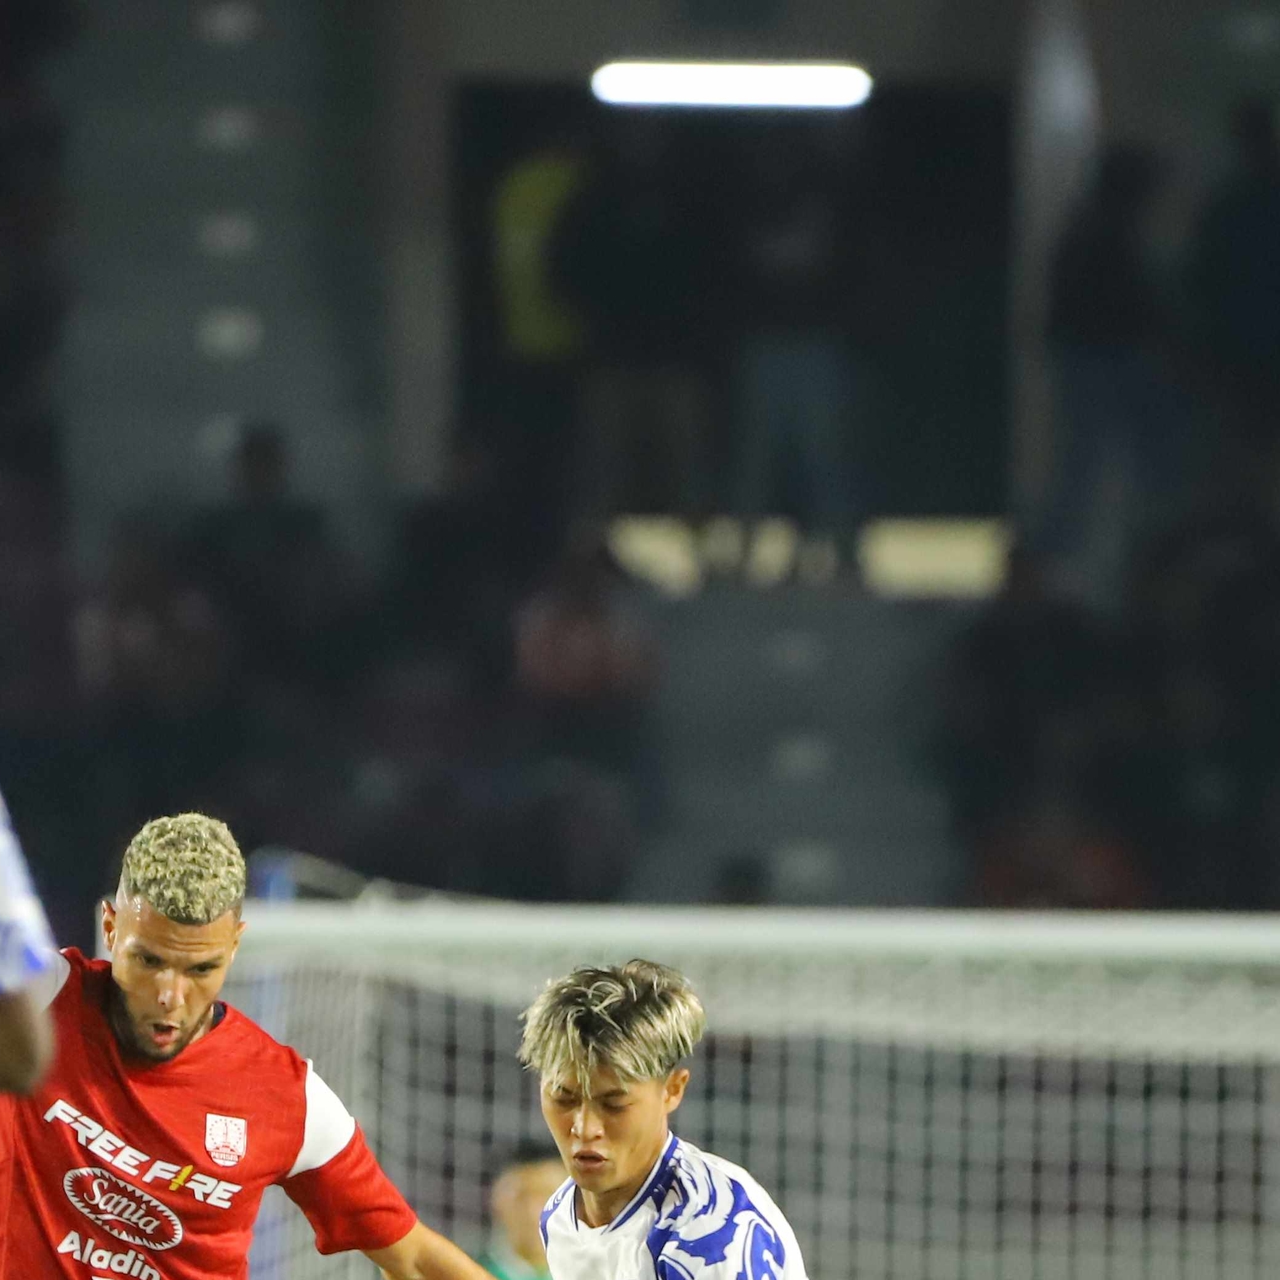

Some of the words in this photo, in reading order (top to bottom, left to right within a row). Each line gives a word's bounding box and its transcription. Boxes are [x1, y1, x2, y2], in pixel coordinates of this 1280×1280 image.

[43, 1099, 151, 1177] FREE
[142, 1160, 243, 1210] FIRE
[83, 1178, 161, 1235] Sania
